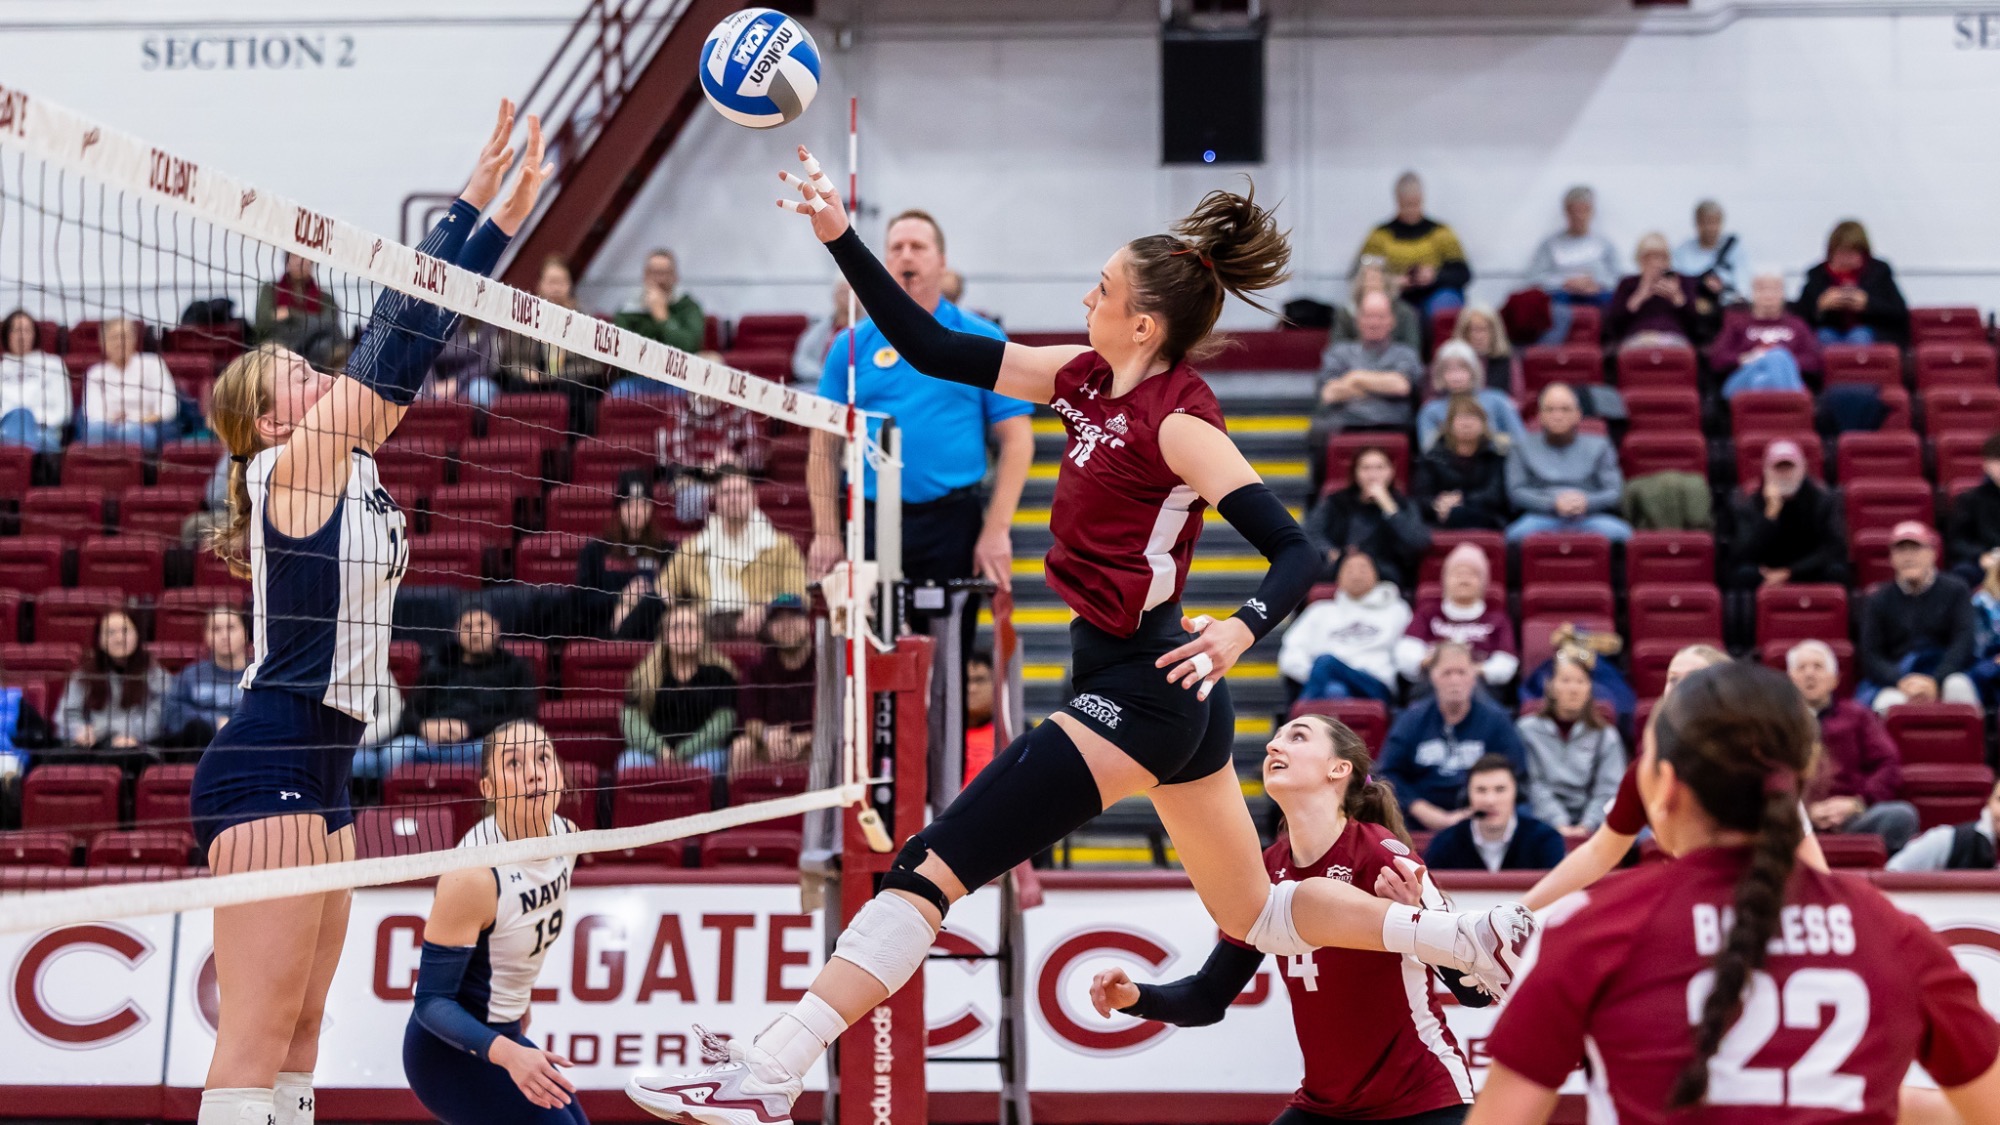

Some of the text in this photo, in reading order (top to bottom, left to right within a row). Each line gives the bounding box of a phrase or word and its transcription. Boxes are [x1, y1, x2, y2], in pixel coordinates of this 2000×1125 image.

[141, 33, 356, 71] SECTION 2
[732, 18, 774, 66] NCAA
[749, 27, 793, 84] molten
[1073, 697, 1122, 722] PATRIOT
[519, 867, 568, 915] NAVY
[529, 908, 563, 958] 19
[1692, 902, 1856, 956] BESS
[372, 914, 814, 1005] CGATE
[9, 921, 156, 1051] C
[545, 1033, 734, 1066] IDERS
[870, 1006, 895, 1073] sports
[1686, 967, 1870, 1112] 22
